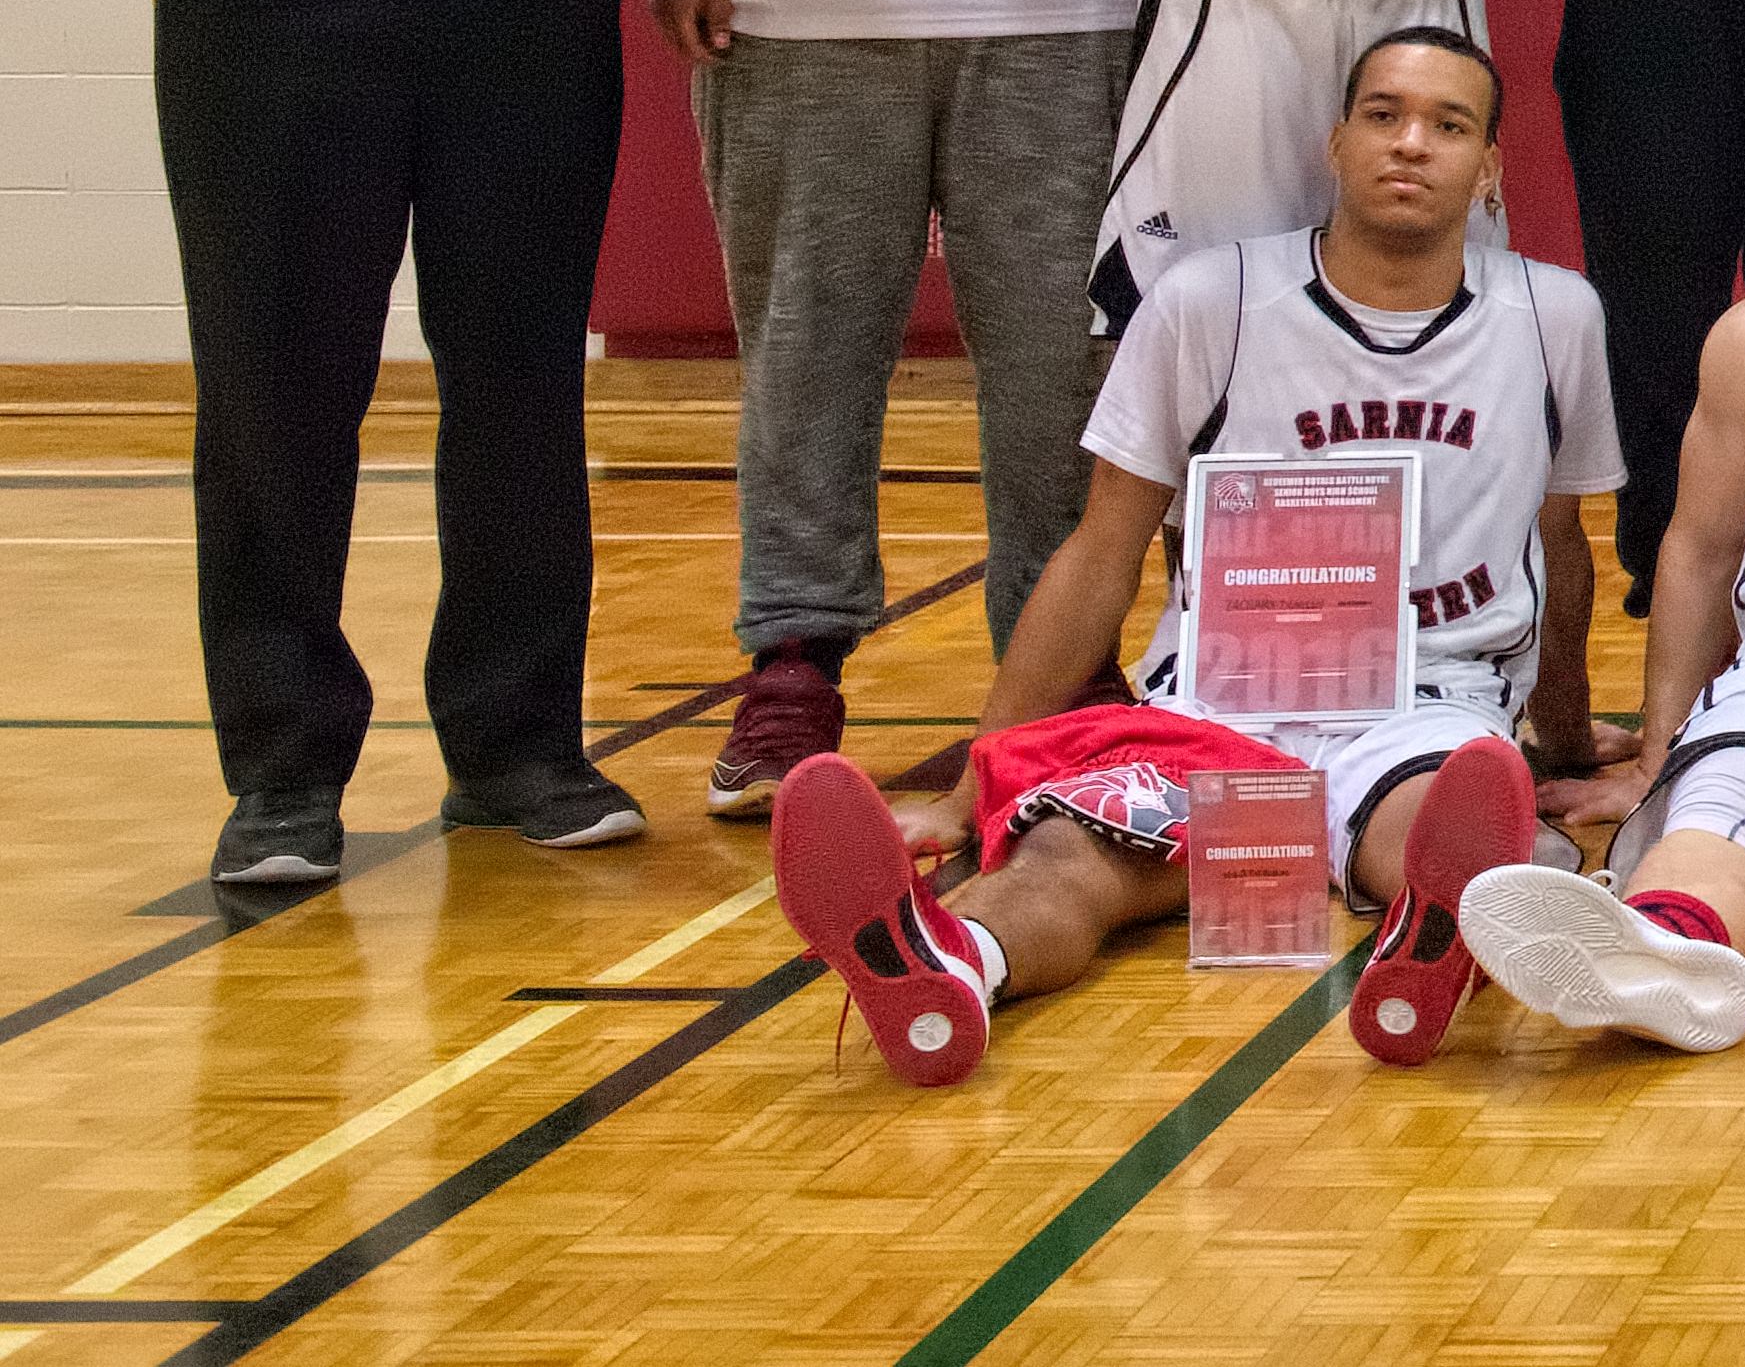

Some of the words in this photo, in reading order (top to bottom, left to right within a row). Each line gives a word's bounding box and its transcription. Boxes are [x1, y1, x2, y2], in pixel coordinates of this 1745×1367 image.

[1295, 401, 1476, 450] SARNIA
[1224, 566, 1376, 586] CONGRATULATIONS
[1206, 844, 1315, 860] CONGRATULATIONS
